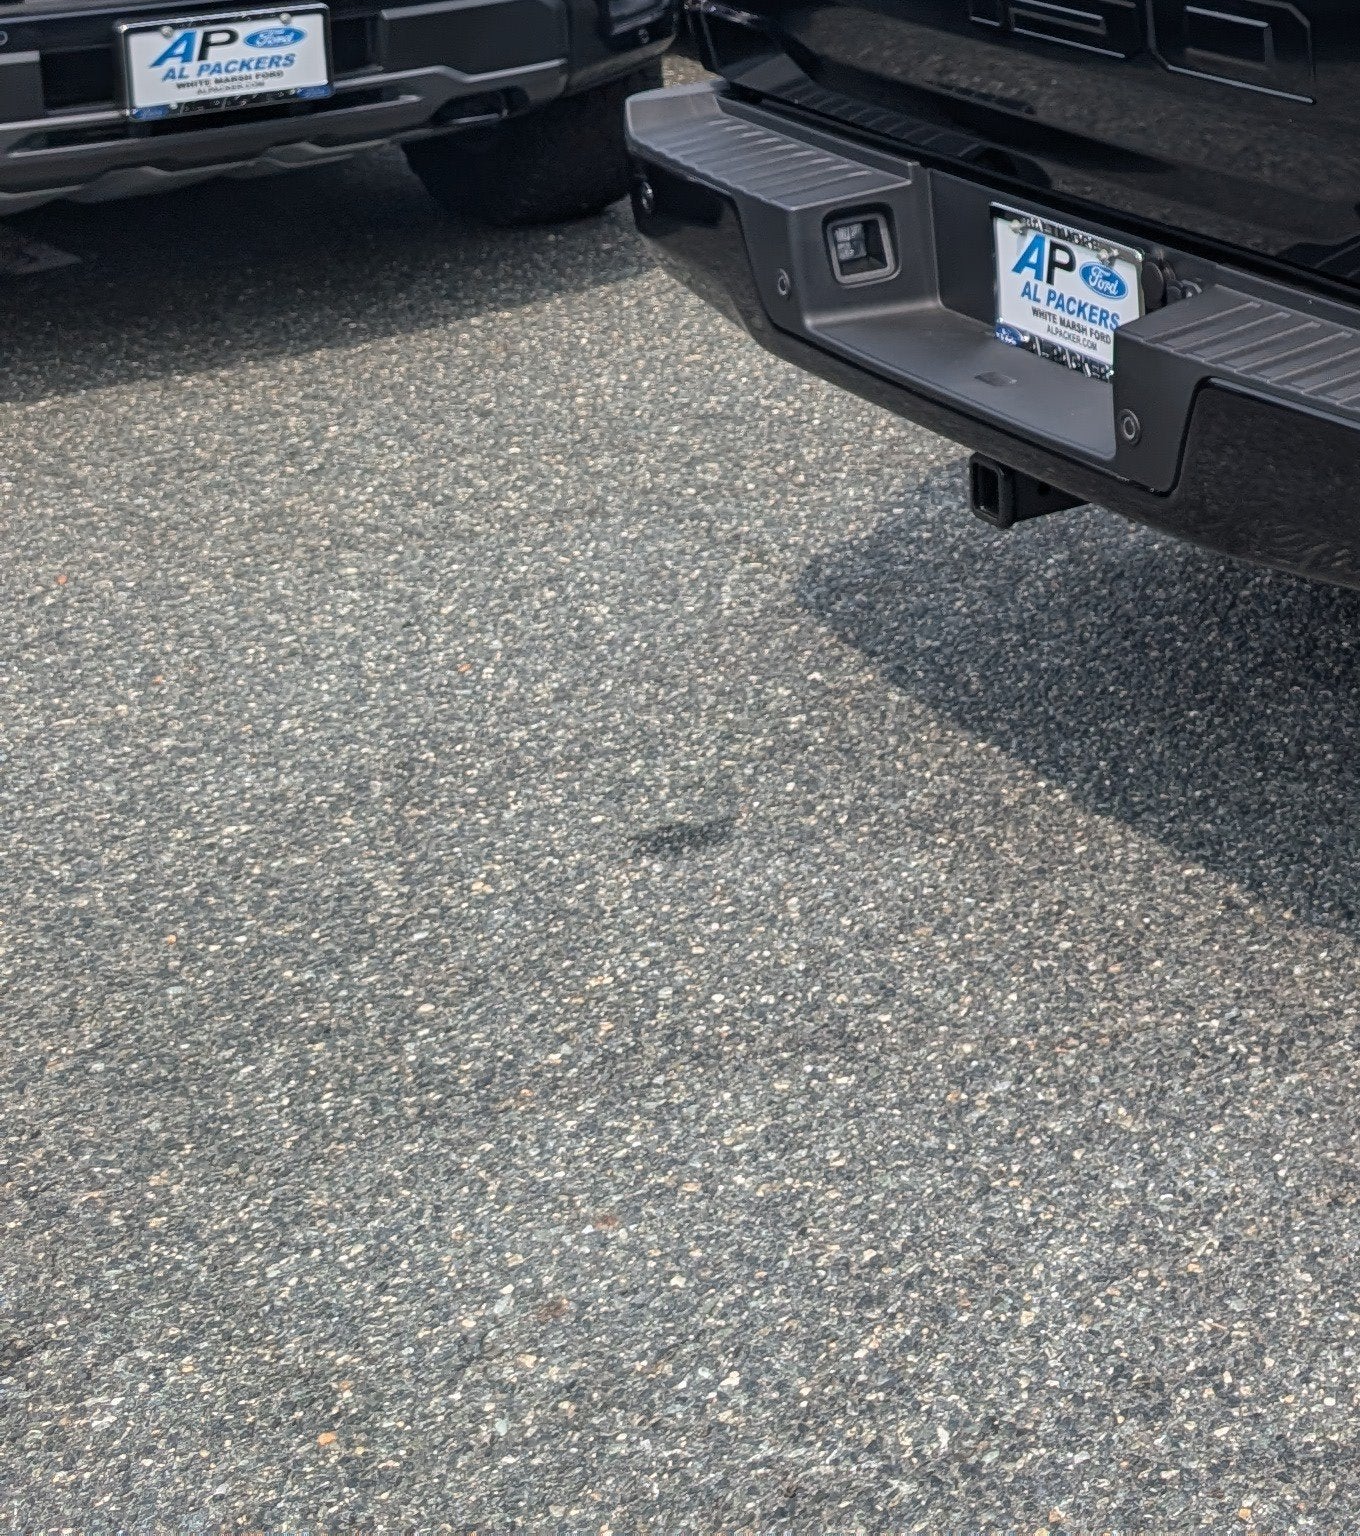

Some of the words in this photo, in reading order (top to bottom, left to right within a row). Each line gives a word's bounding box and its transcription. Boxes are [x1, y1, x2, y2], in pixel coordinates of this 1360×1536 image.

[149, 29, 239, 68] AP
[162, 66, 189, 82] AL
[197, 53, 296, 78] PACKERS
[1011, 233, 1076, 286] AP
[1020, 281, 1041, 303] AL
[1045, 289, 1121, 331] PACKERS
[1031, 306, 1057, 324] WHITE
[1059, 314, 1088, 337] MARSH
[1089, 326, 1112, 345] FORD
[1047, 324, 1098, 351] ALPACKER.COM
